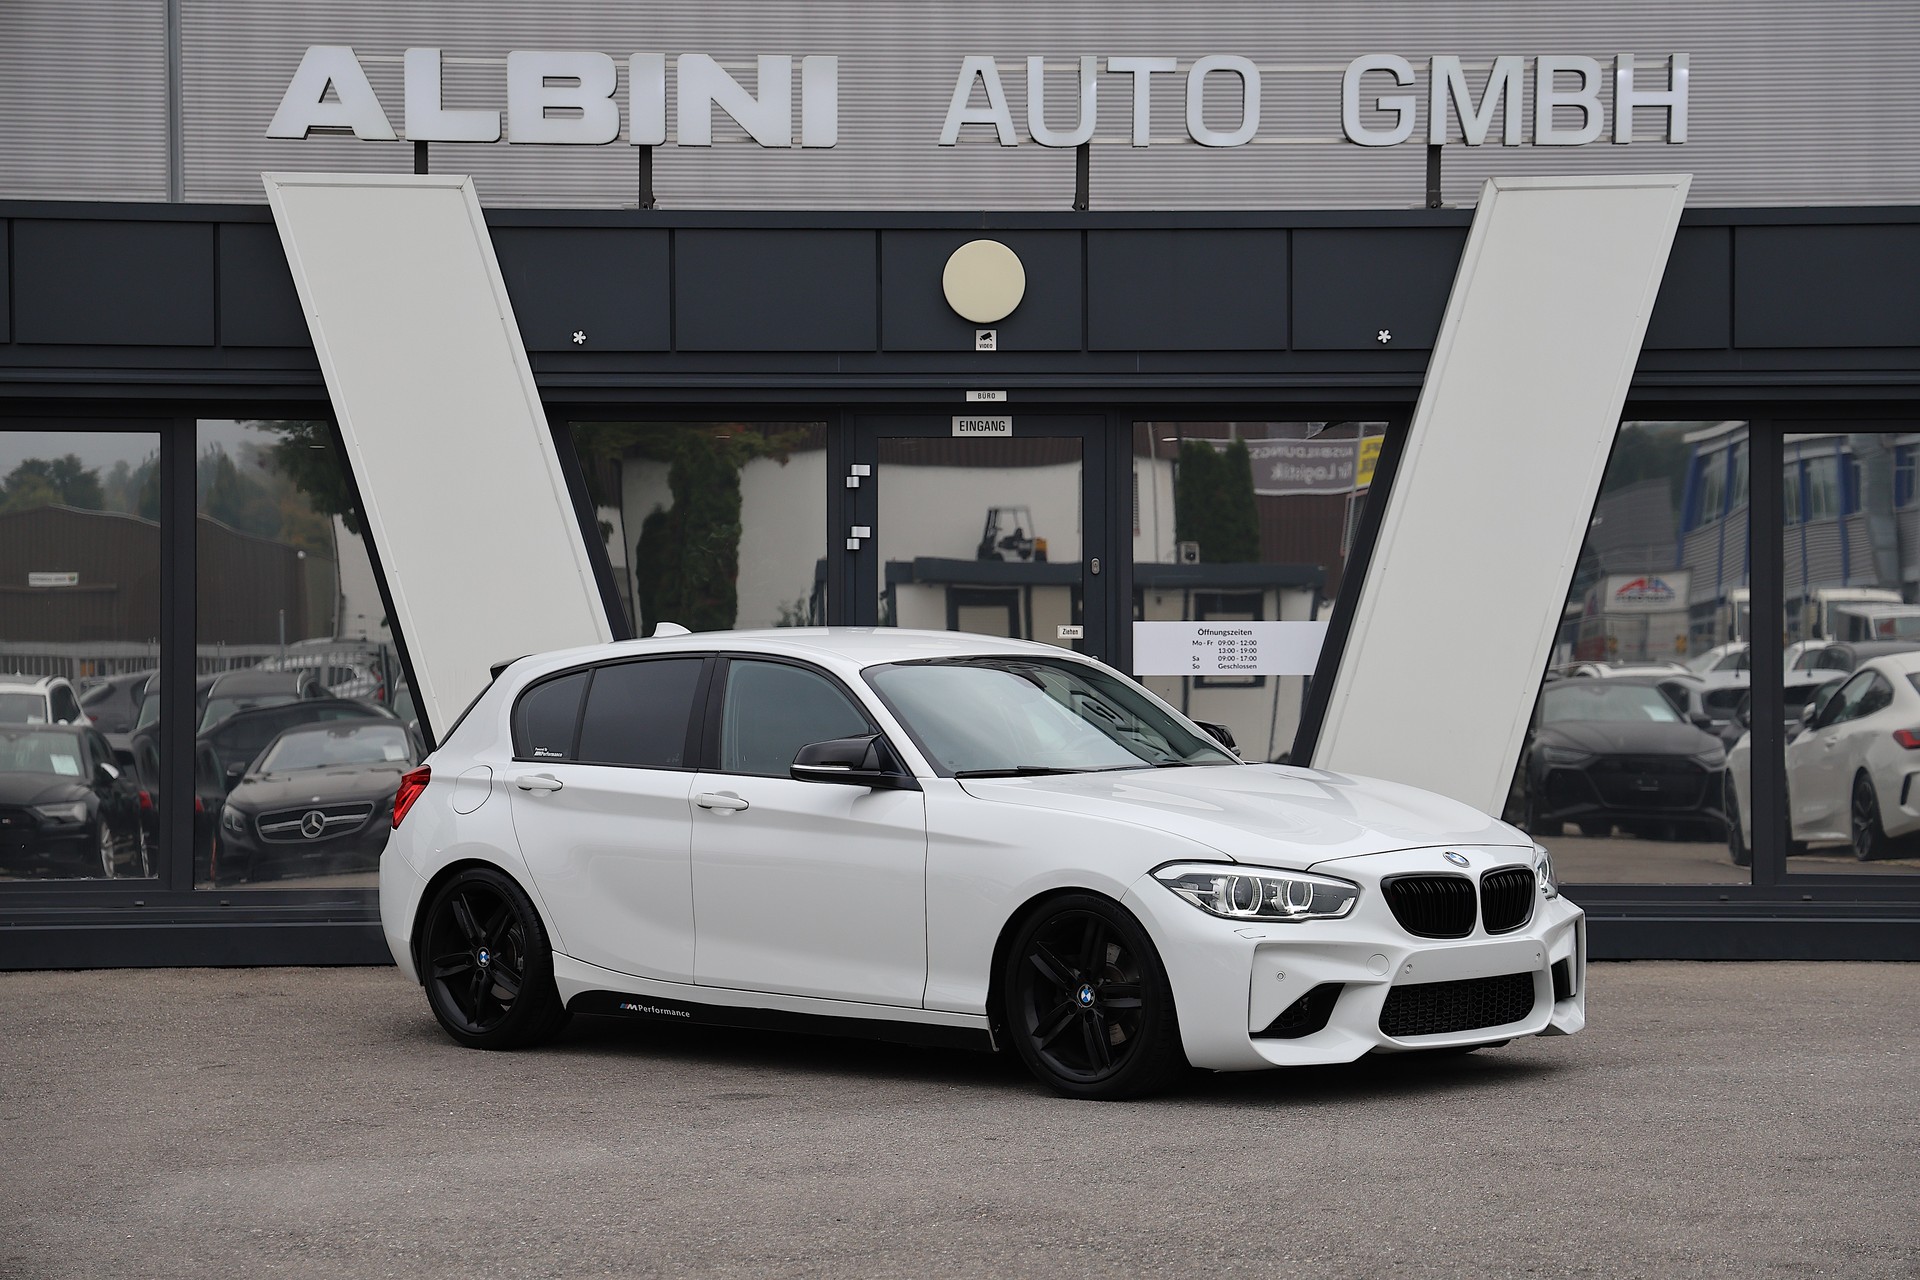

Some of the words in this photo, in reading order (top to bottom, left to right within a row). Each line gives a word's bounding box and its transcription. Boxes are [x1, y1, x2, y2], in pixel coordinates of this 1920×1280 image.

[266, 45, 838, 148] ALBINI
[938, 54, 1262, 147] AUTO
[1341, 52, 1690, 146] GMBH
[959, 420, 1006, 432] EINGANG
[1197, 628, 1253, 637] Öffnungszeiten
